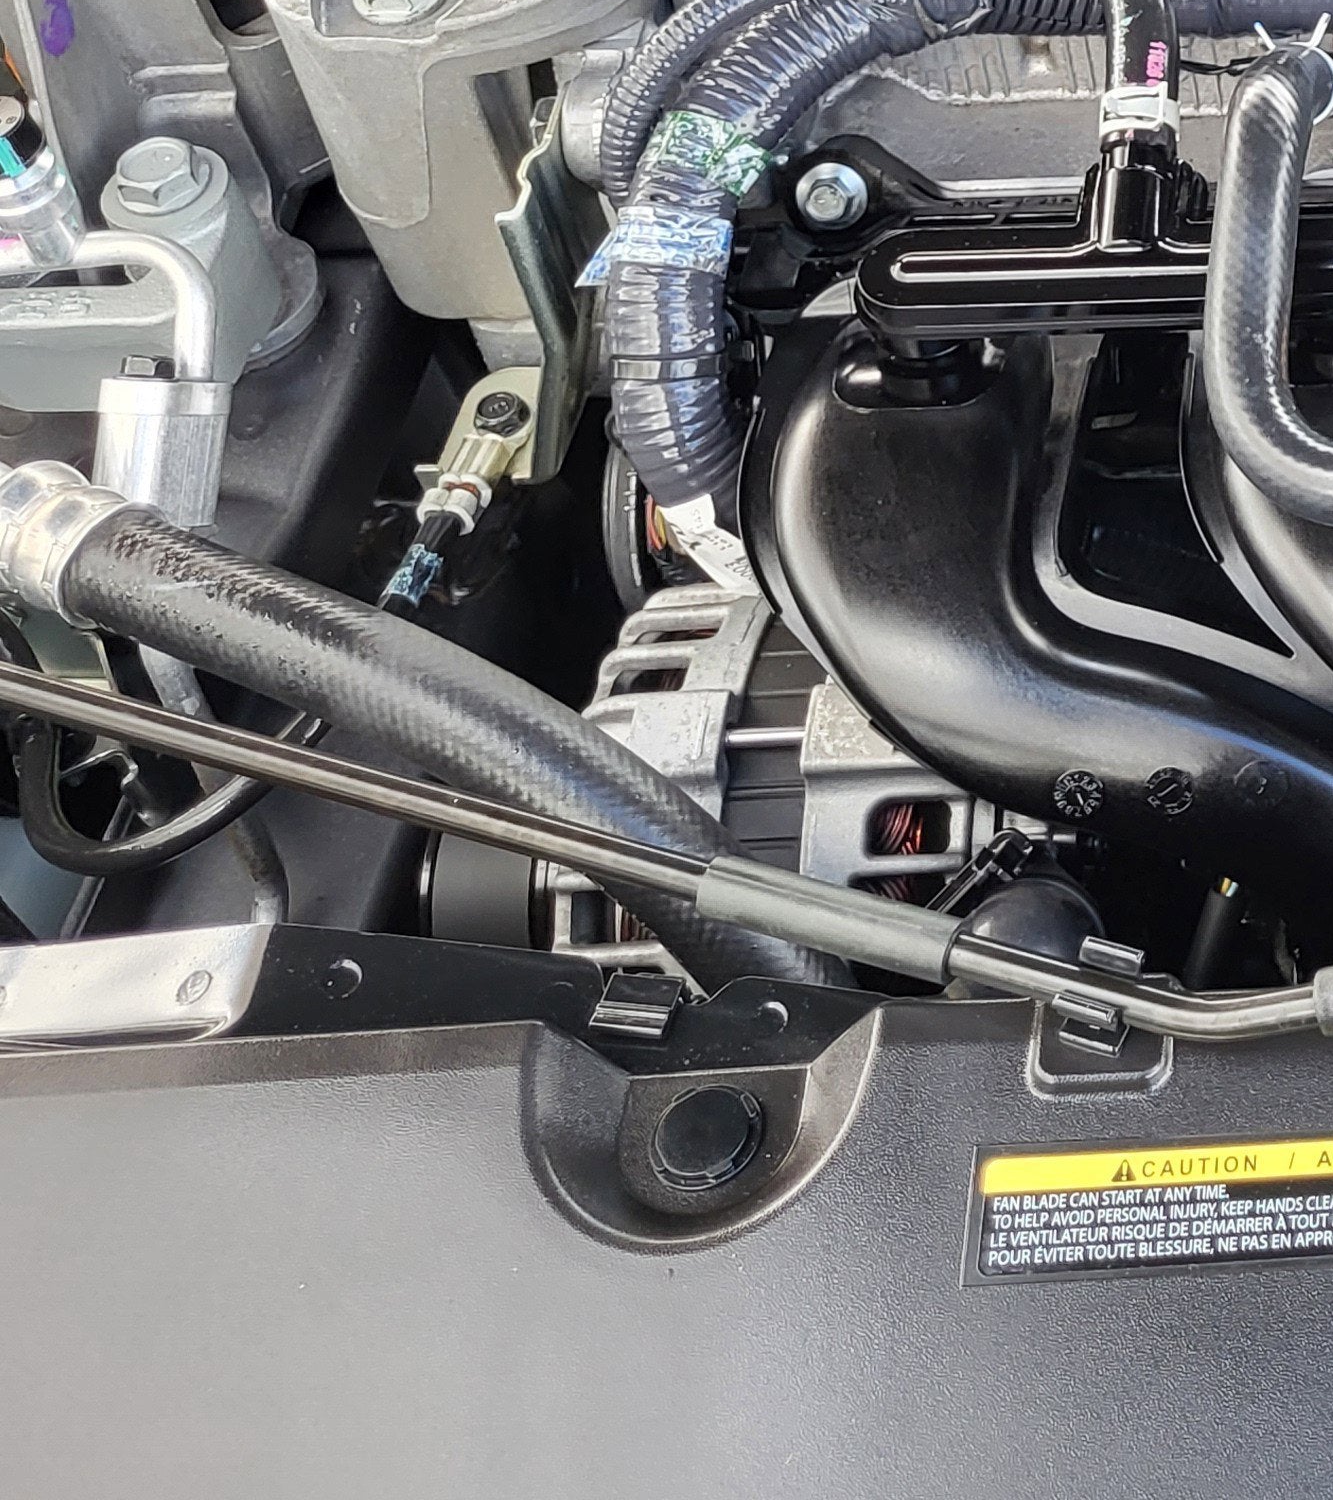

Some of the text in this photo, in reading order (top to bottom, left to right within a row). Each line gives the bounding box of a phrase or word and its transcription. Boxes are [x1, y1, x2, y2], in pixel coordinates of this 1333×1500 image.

[1142, 1154, 1257, 1177] CAUTION
[1288, 1152, 1295, 1169] /
[993, 1184, 1229, 1212] FAN BLADE CAN START AT ANY TIME.
[993, 1214, 1012, 1229] TO
[1015, 1211, 1048, 1228] HELP
[1051, 1210, 1095, 1227] AVOID
[1098, 1207, 1166, 1224] PERSONAL
[1170, 1203, 1218, 1220] INJURY,
[1221, 1201, 1252, 1217] KEEP
[1256, 1196, 1303, 1214] HANDS
[990, 1232, 1007, 1248] LE
[1010, 1227, 1108, 1246] VENTILATEUR
[1112, 1223, 1165, 1242] RISQUE
[1168, 1222, 1189, 1237] DE
[1192, 1215, 1272, 1236] DÉMARRER
[1275, 1213, 1287, 1230] À
[1289, 1213, 1328, 1230] TOUT
[988, 1248, 1031, 1266] POUR
[1034, 1243, 1084, 1264] ÉVITER
[1086, 1244, 1135, 1261] TOUTE
[1138, 1237, 1215, 1257] BLESSURE,
[1218, 1236, 1238, 1252] NE
[1241, 1235, 1268, 1251] PAS
[1271, 1233, 1290, 1249] EN
